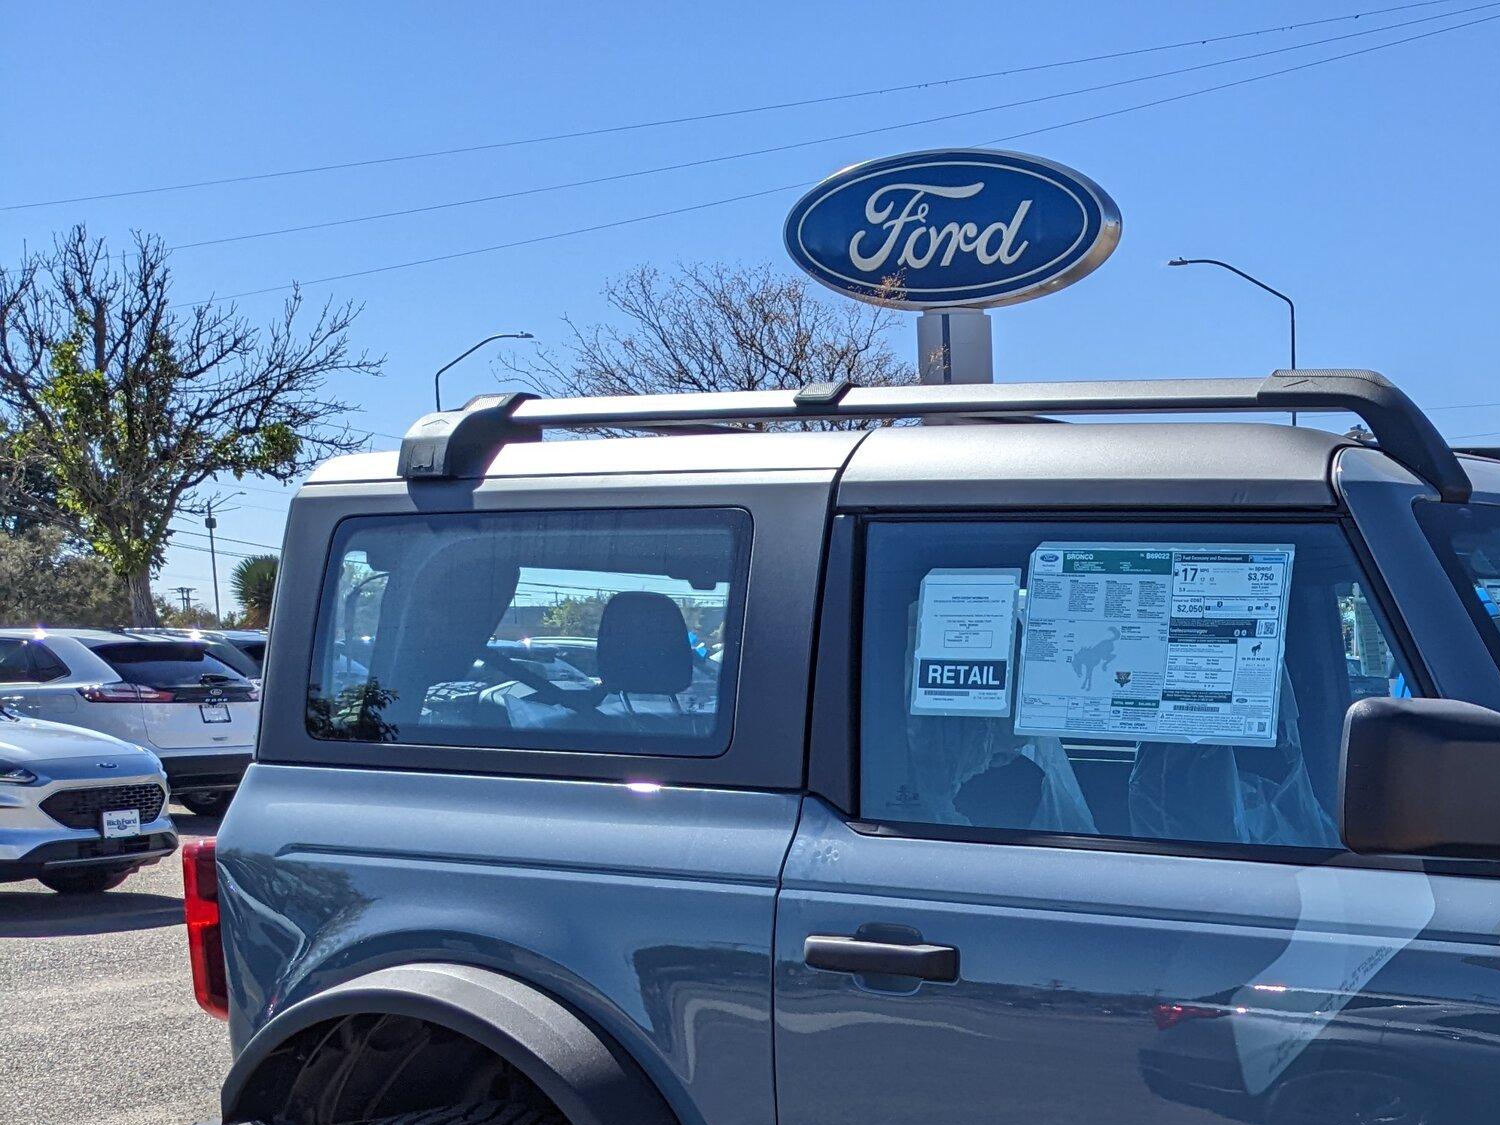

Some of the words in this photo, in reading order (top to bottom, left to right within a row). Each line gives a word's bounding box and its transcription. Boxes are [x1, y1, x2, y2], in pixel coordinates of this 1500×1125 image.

[849, 181, 1033, 272] Ford
[1066, 553, 1094, 561] BRONCO
[1181, 567, 1199, 582] 17
[1247, 572, 1275, 582] $3,750
[1176, 604, 1203, 613] $2,050
[927, 664, 1000, 686] RETAIL
[121, 817, 138, 826] Ford
